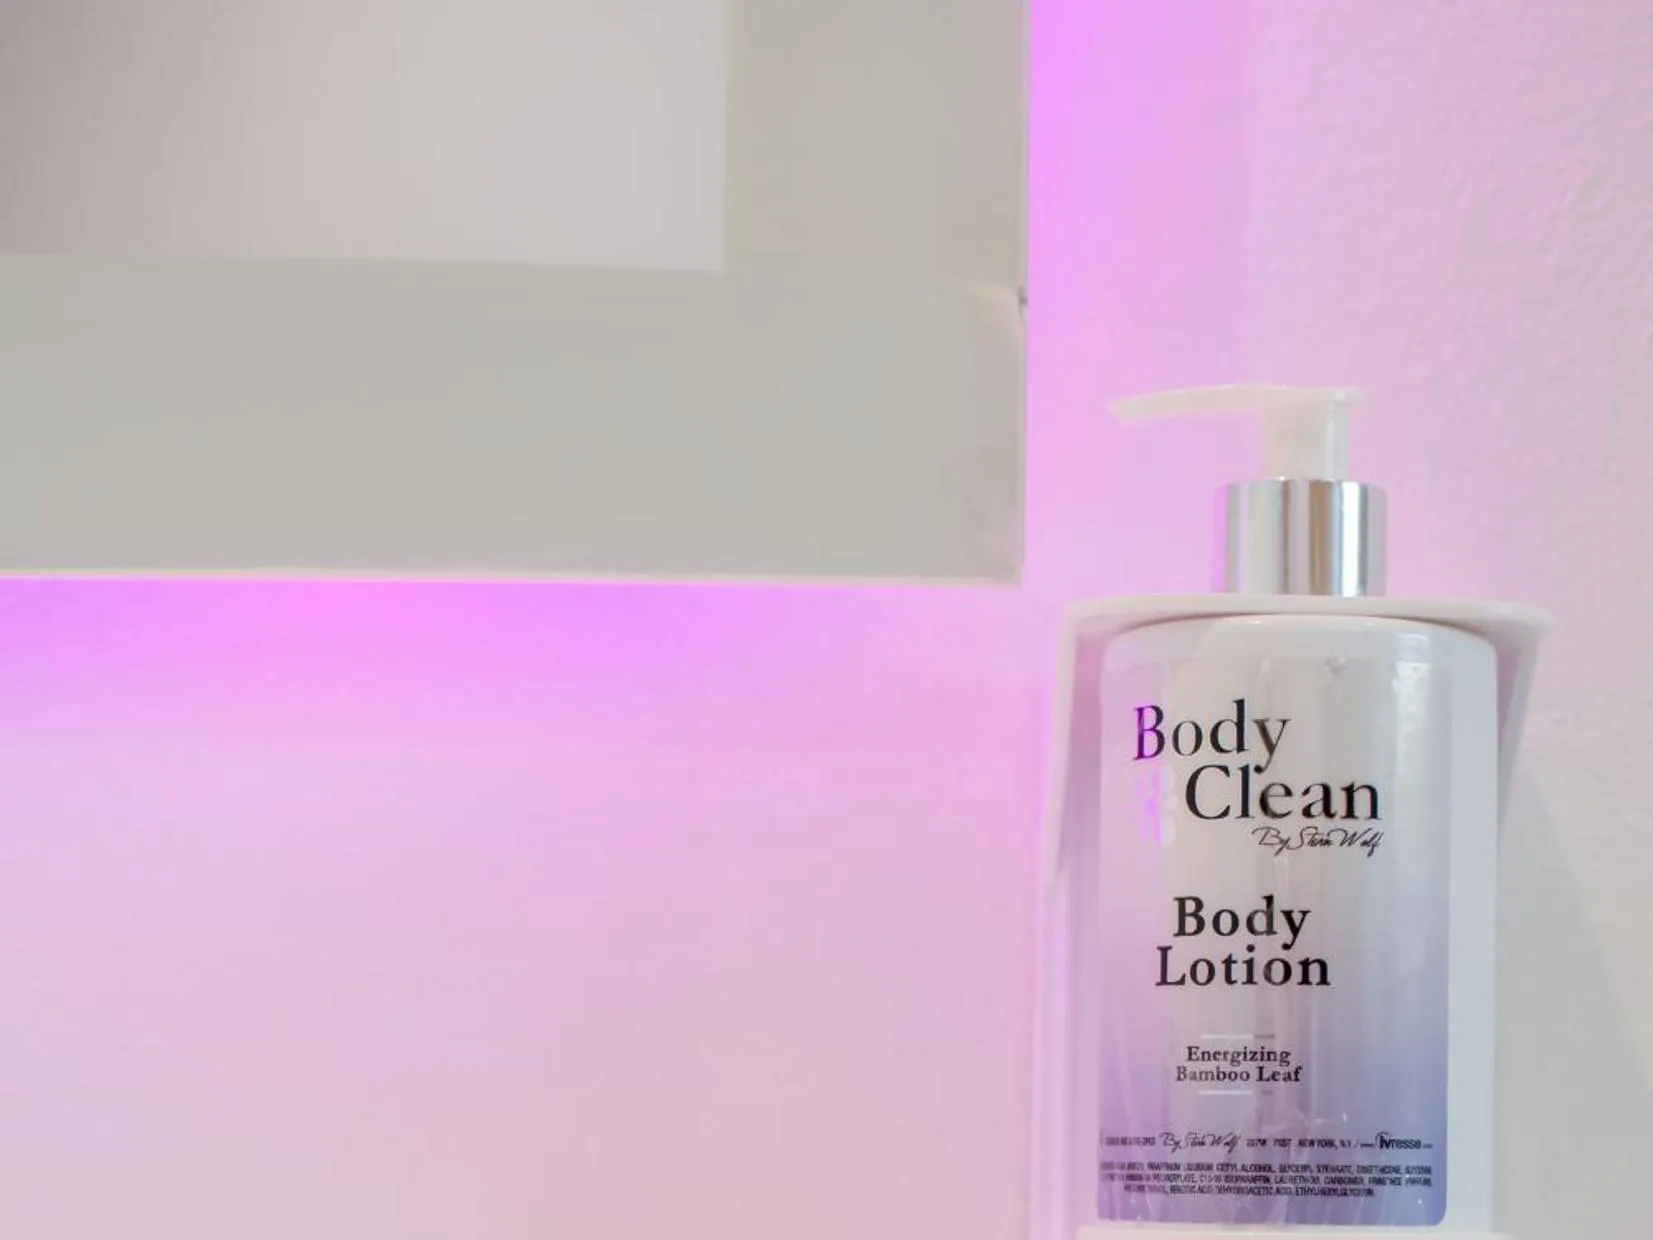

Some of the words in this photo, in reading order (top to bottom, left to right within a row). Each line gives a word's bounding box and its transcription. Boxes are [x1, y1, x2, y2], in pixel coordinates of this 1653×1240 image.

[1133, 698, 1292, 774] Body
[1185, 763, 1382, 820] Clean
[1251, 826, 1291, 857] By
[1172, 894, 1311, 950] Body
[1155, 944, 1331, 986] Lotion
[1176, 1066, 1250, 1082] Bamboo
[1255, 1066, 1303, 1082] Leaf
[1186, 1045, 1292, 1067] Energizing
